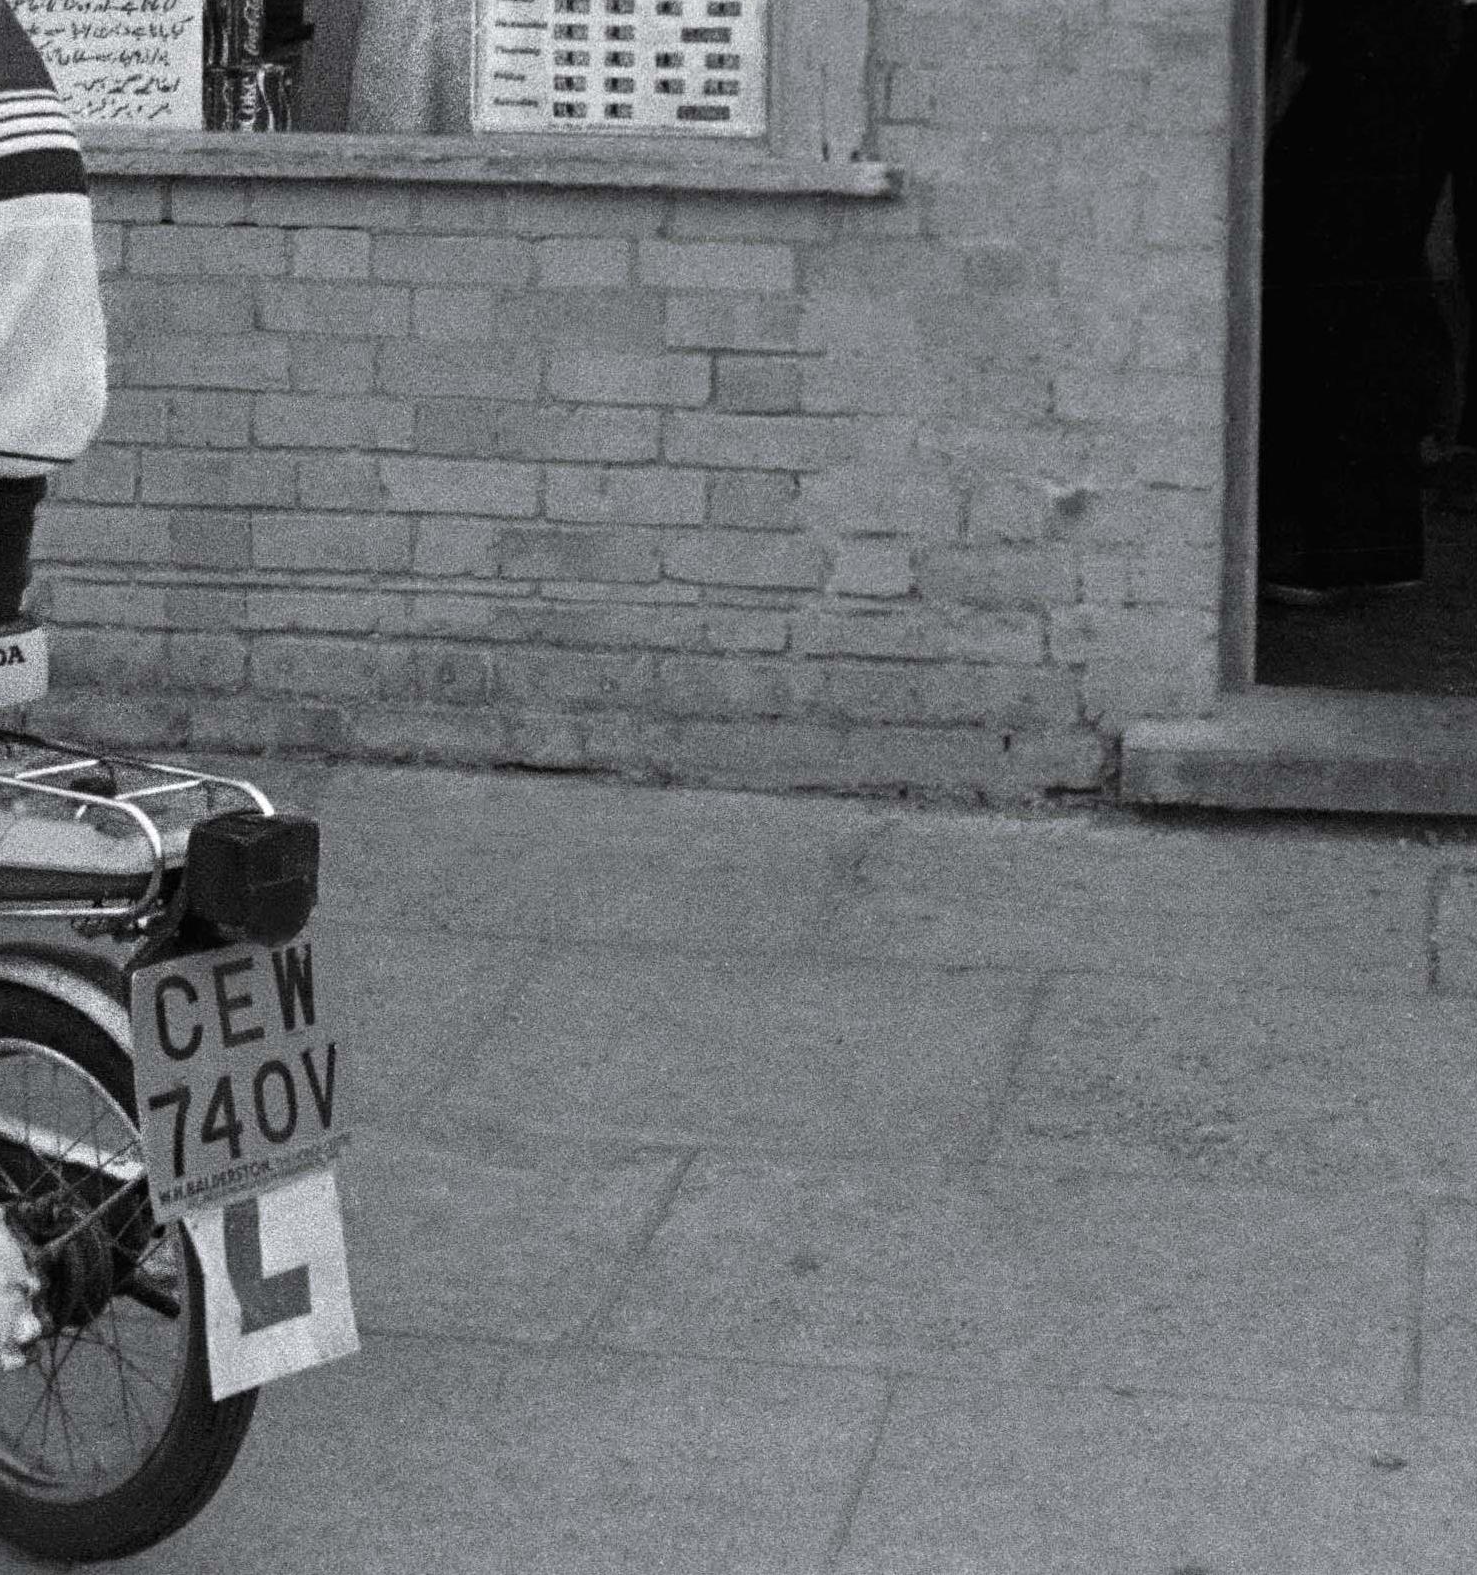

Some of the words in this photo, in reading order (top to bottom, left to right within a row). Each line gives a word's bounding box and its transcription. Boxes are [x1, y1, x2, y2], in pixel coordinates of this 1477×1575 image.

[154, 943, 317, 1062] CEW
[148, 1042, 338, 1178] 740V
[223, 1197, 312, 1336] L
